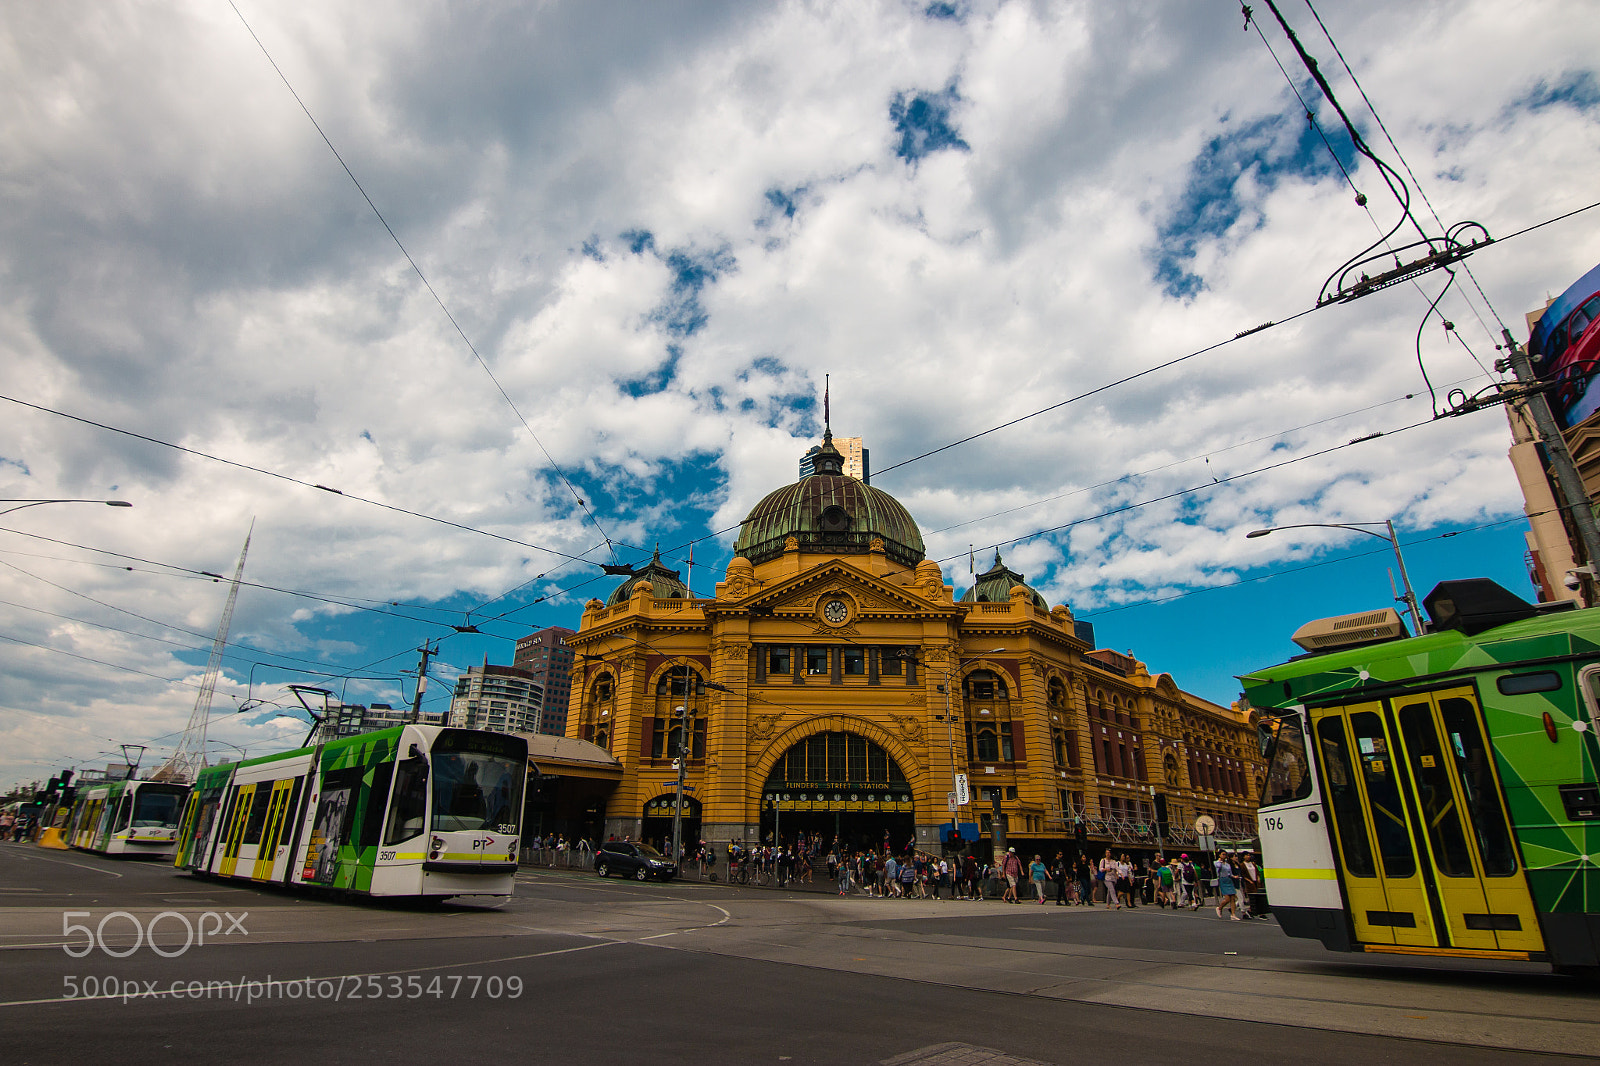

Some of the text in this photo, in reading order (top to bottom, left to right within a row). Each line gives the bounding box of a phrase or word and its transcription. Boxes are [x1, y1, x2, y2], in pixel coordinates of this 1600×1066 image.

[858, 782, 889, 790] STATION
[497, 823, 516, 834] 3507
[1264, 817, 1284, 831] 196
[379, 851, 396, 861] 3507
